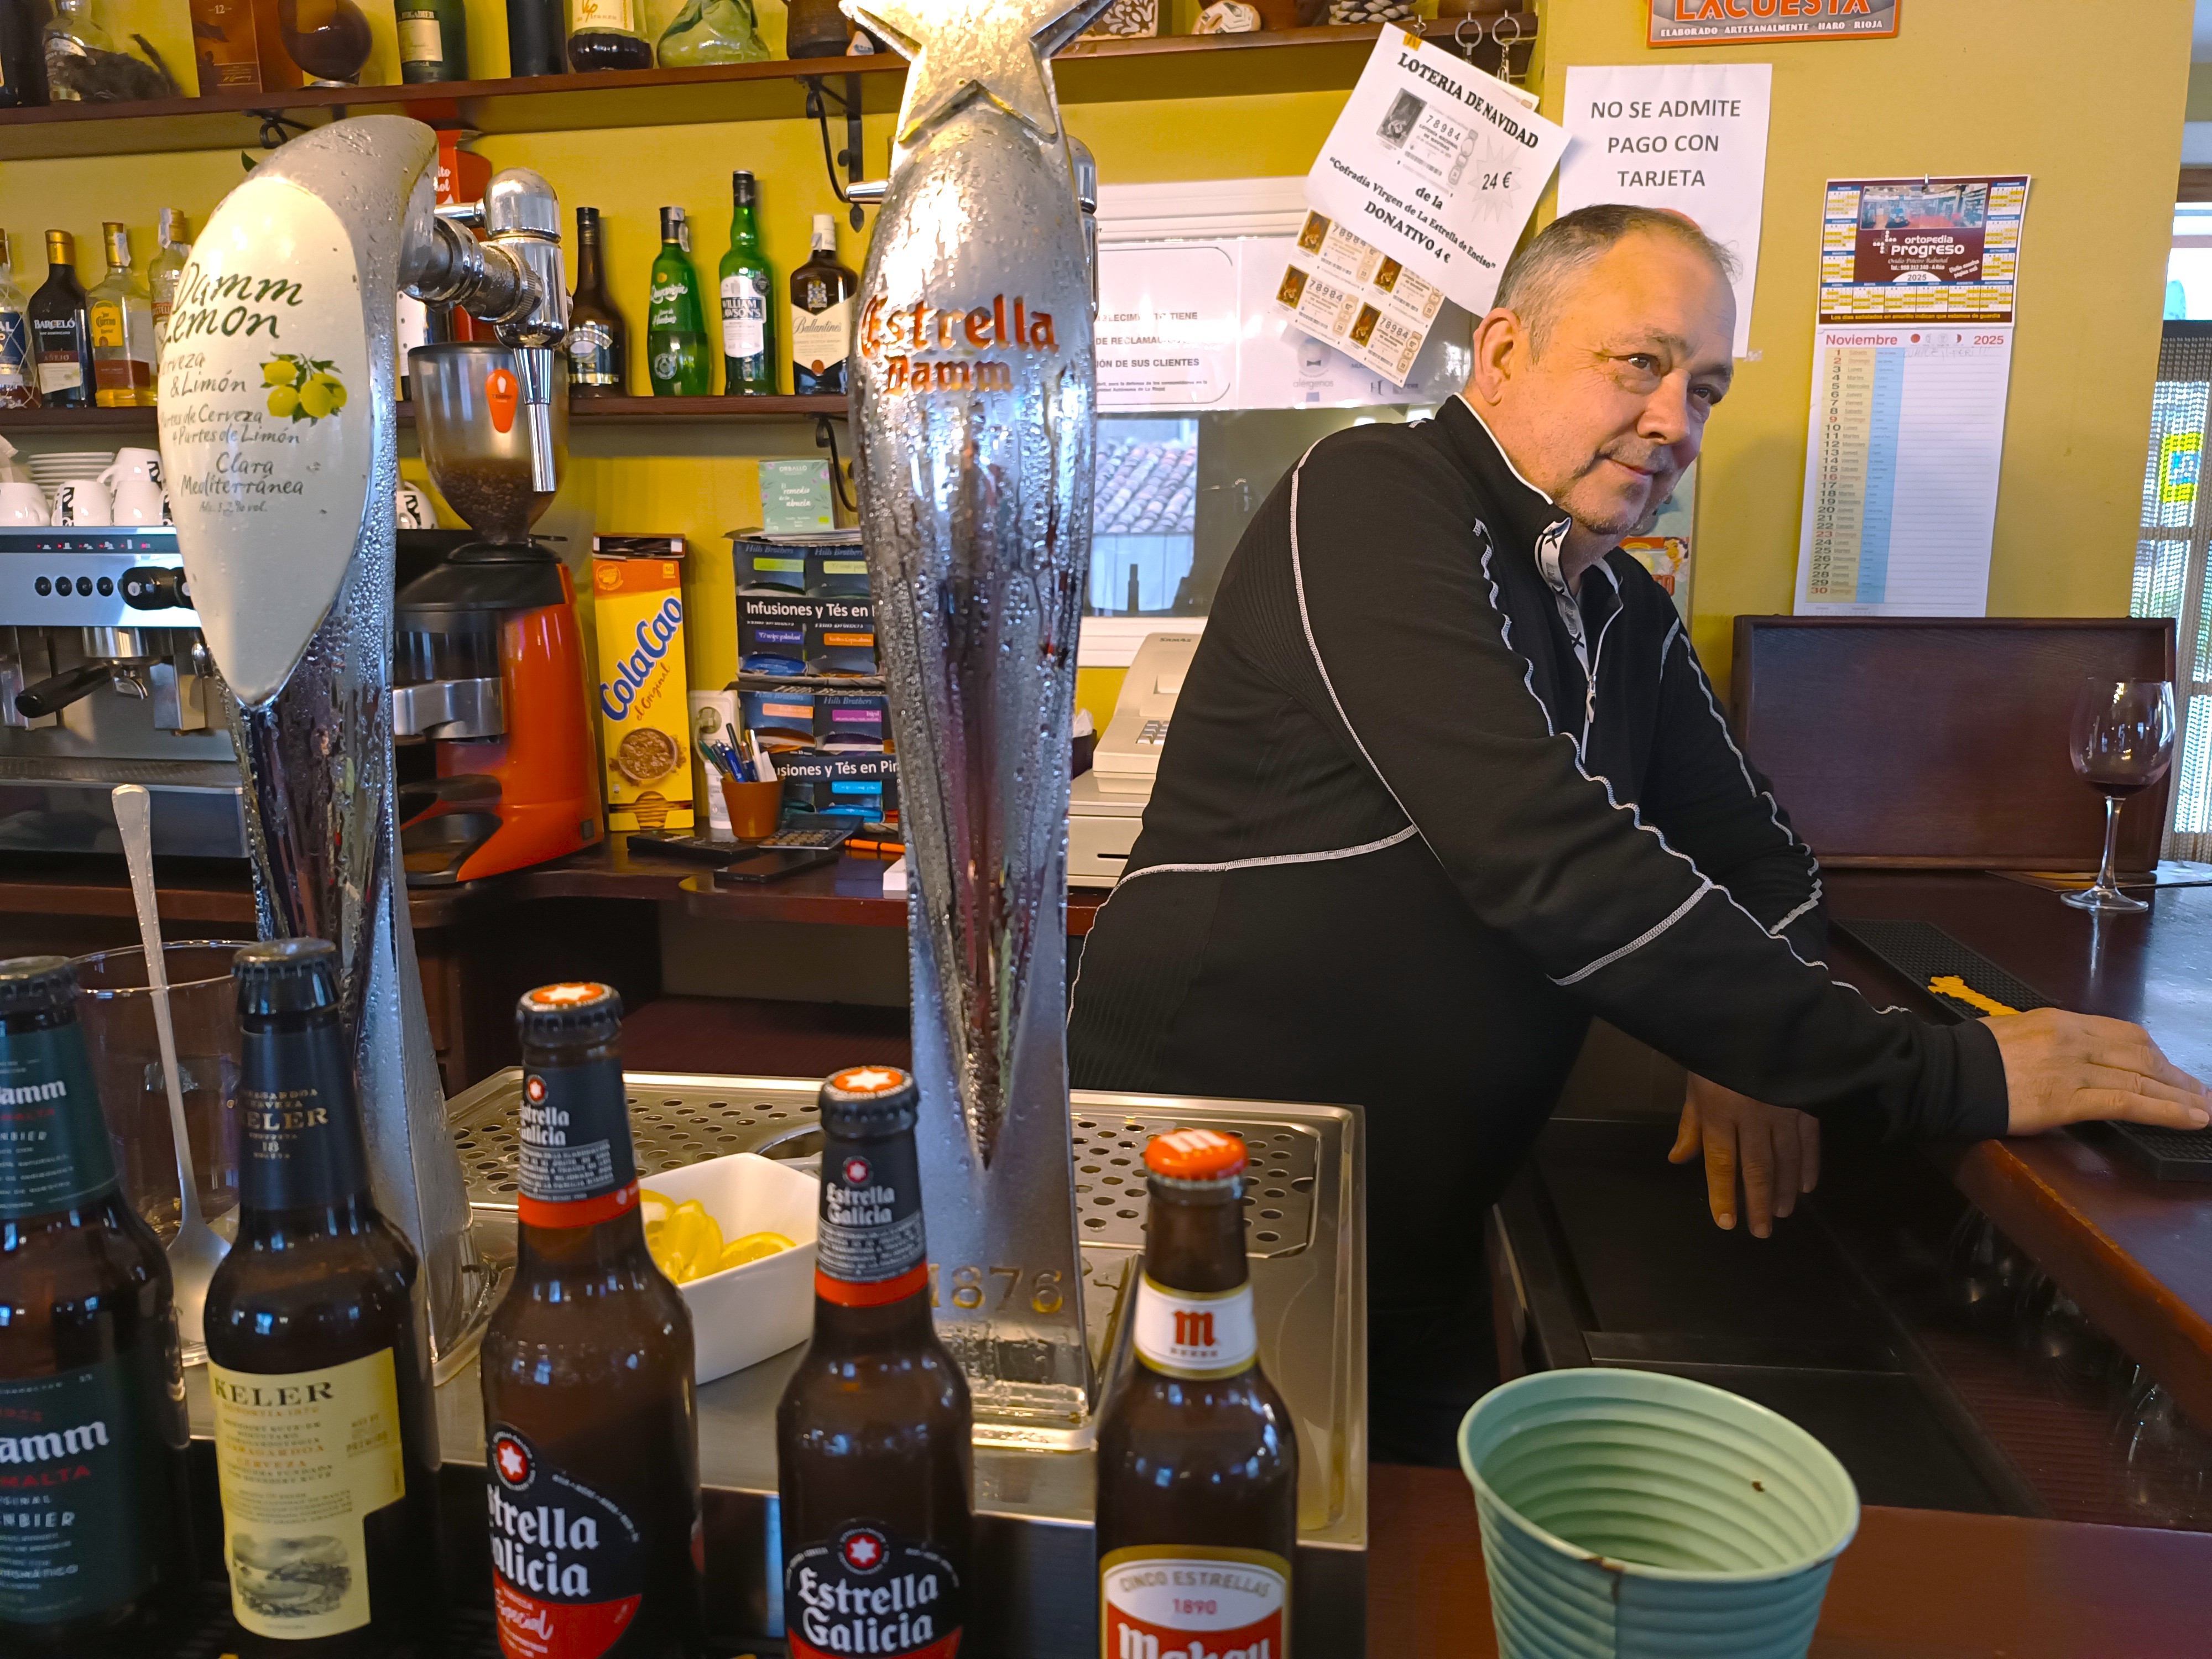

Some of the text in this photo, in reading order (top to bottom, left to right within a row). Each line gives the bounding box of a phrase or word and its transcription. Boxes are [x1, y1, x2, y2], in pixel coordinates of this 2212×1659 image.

[1661, 20, 1882, 37] ELABORADO ARTESANALMENTE HARO RIOJA
[1397, 52, 1463, 101] LOTERIA
[1464, 91, 1484, 113] DE
[1482, 102, 1539, 149] NAVIDAD
[1591, 100, 1741, 118] NO SE ADMITE
[1426, 115, 1462, 142] 78984
[1608, 134, 1719, 153] PAGO CON
[1481, 171, 1512, 190] 24 €
[1618, 170, 1704, 186] TARJETA
[1415, 187, 1443, 210] de la
[1373, 183, 1402, 208] Virgen
[1405, 204, 1416, 216] de
[1416, 211, 1428, 225] La
[1428, 218, 1458, 244] Estrella
[1458, 239, 1468, 252] de
[1364, 201, 1452, 264] DONATIVO 4 €
[173, 262, 303, 314] Damm
[1309, 280, 1343, 301] 78984
[34, 317, 75, 330] BARCELÓ
[793, 316, 842, 335] Ballantine's
[860, 294, 1060, 359] Estrella
[1380, 318, 1408, 340] 78984
[1826, 334, 2004, 345] Noviembre 2025
[1153, 358, 1199, 367] CLIENTES
[885, 355, 1013, 396] Damm
[199, 404, 263, 424] Cerveza
[241, 425, 300, 444] Limón
[216, 452, 274, 474] Clara
[181, 472, 303, 496] Mediterránea
[747, 602, 868, 619] Infusiones y Tés en
[600, 597, 683, 721] ColaCao
[825, 766, 832, 778] y
[836, 761, 857, 774] Tés
[860, 764, 877, 774] en
[0, 1080, 67, 1105] amm
[247, 1108, 328, 1131] ELER
[520, 1102, 570, 1126] strella
[826, 1183, 895, 1206] Estrella
[827, 1204, 892, 1225] Galicia
[214, 1377, 334, 1407] KELER
[0, 1420, 110, 1464] amm
[490, 1535, 591, 1597] alicia
[797, 1567, 940, 1616] Estrella
[1119, 1571, 1271, 1598] CINCO ESTRELLAS
[1173, 1598, 1218, 1615] 1890
[802, 1606, 934, 1653] Galicia
